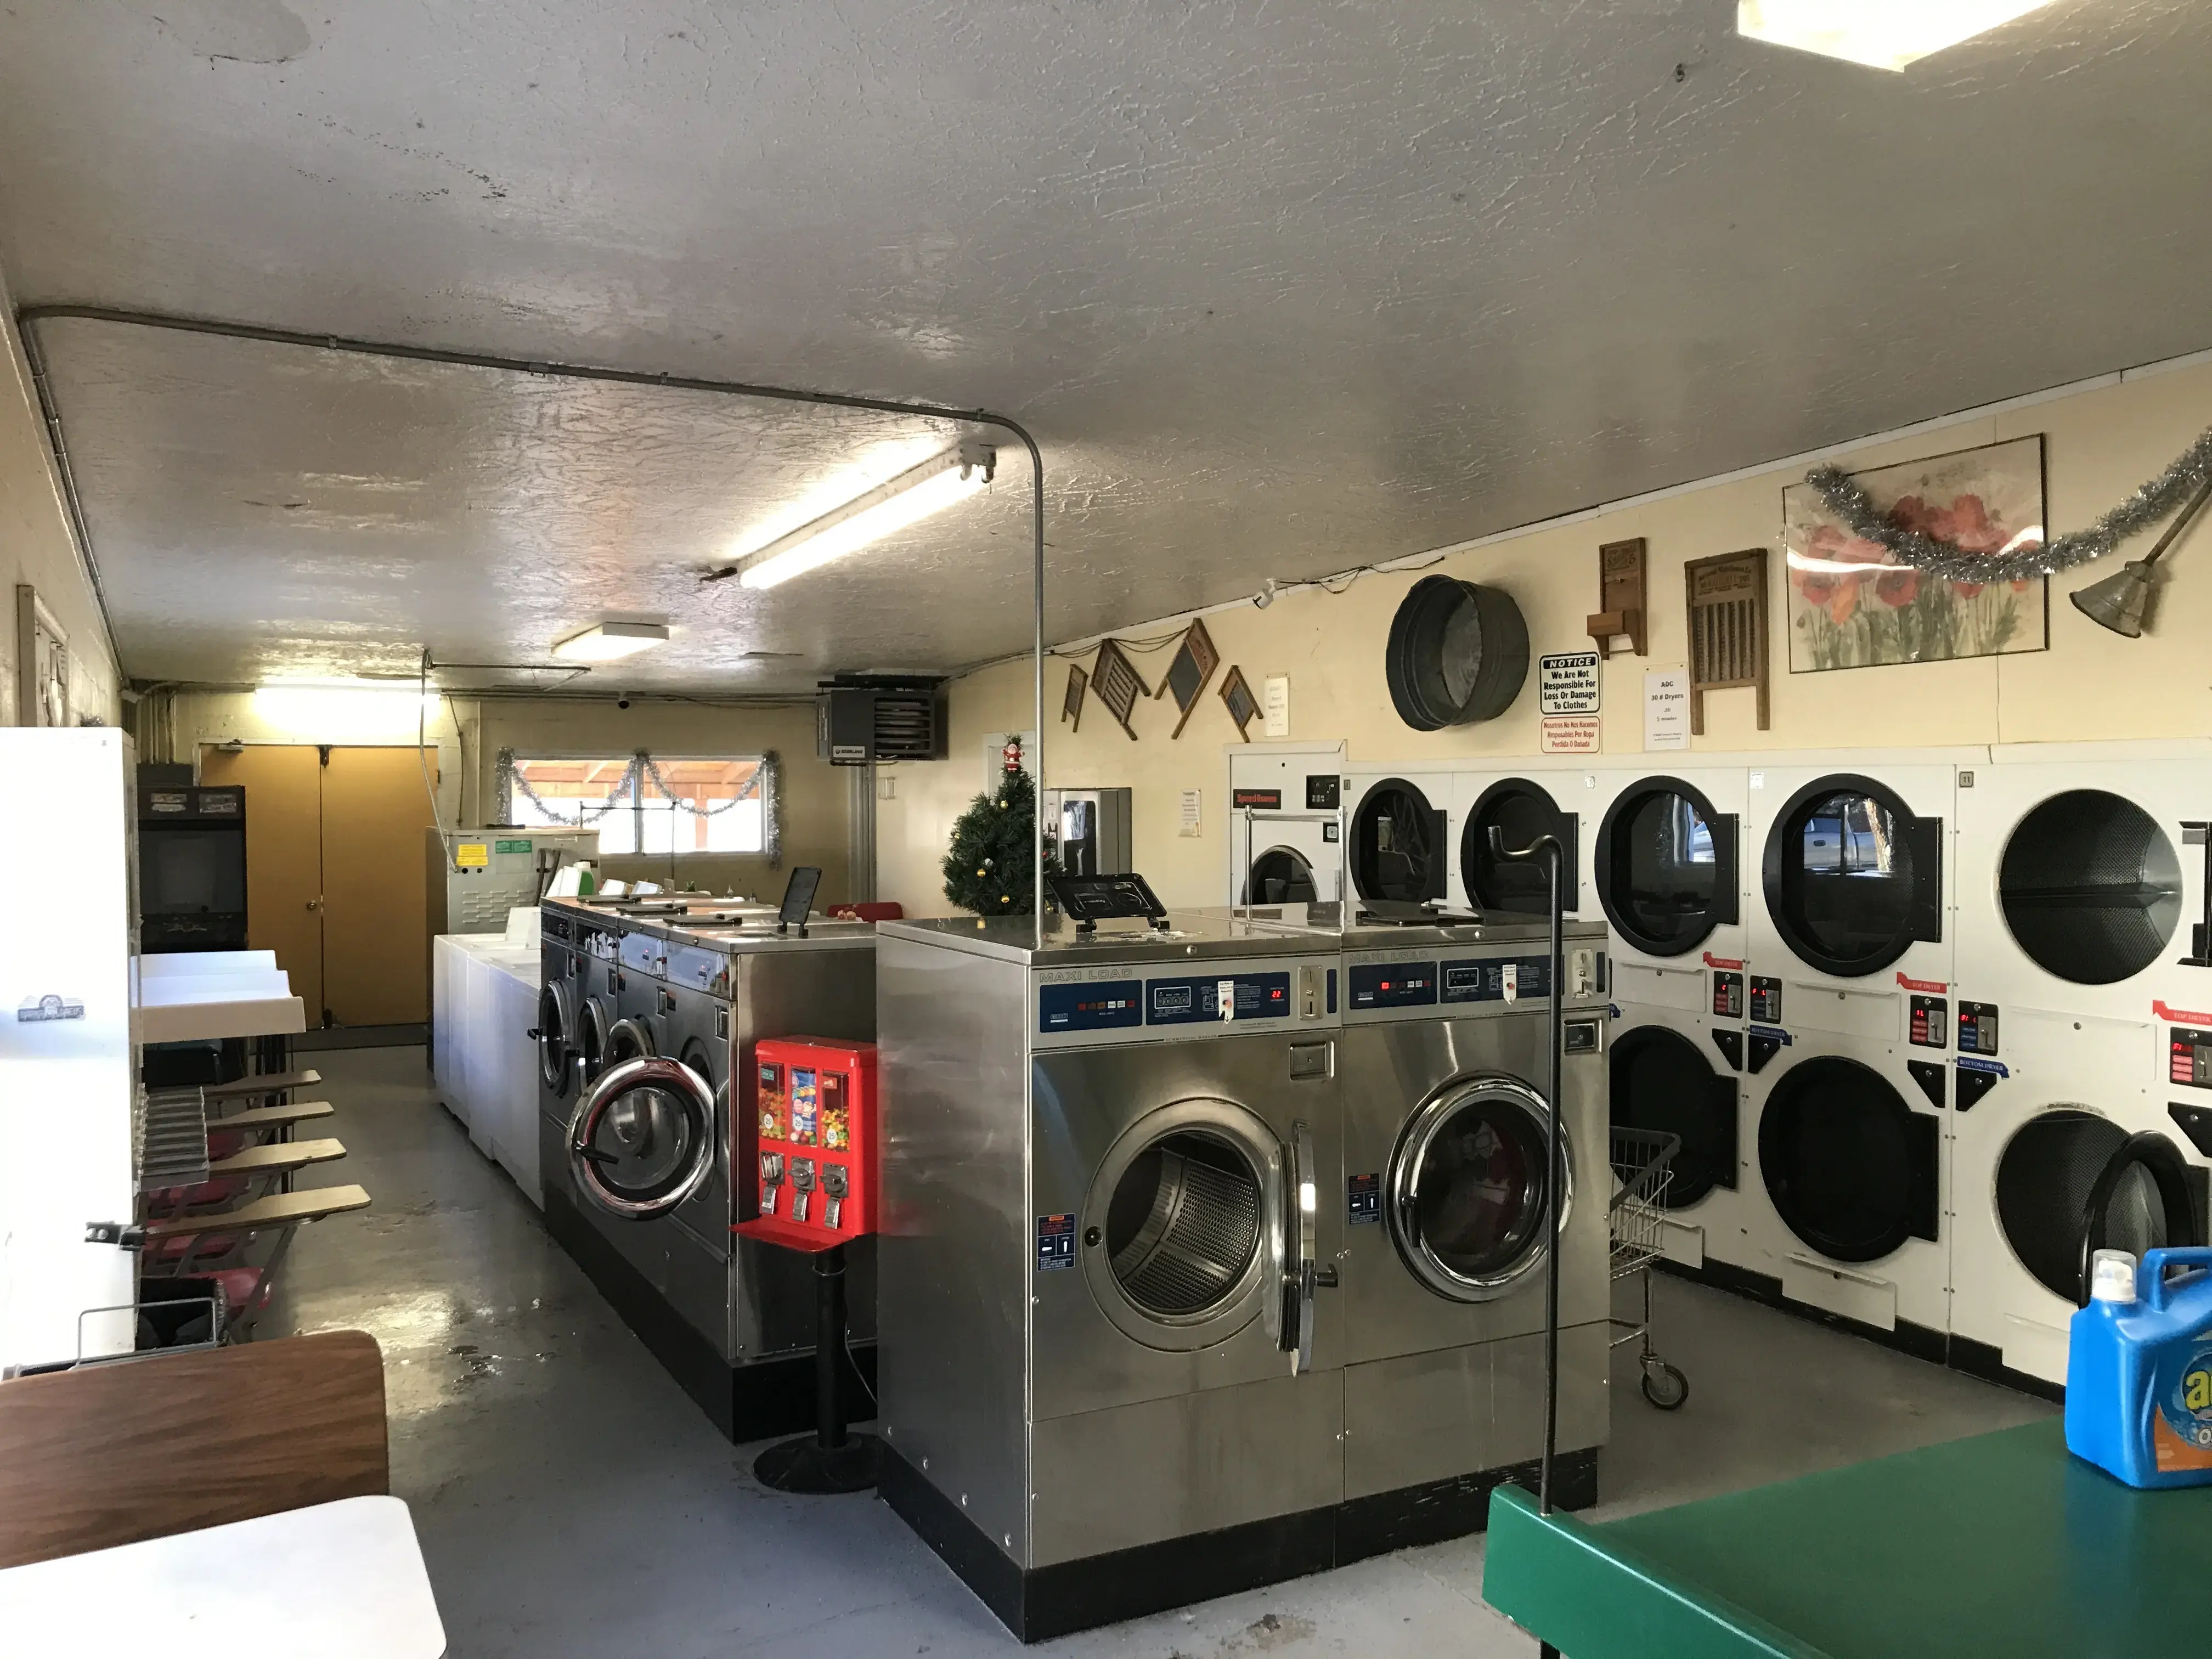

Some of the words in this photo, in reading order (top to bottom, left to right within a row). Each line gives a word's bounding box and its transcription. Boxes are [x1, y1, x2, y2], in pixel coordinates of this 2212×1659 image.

[1549, 658, 1592, 668] NOTICE
[1544, 680, 1584, 691] Responsible
[1571, 691, 1596, 699] Damage
[1237, 794, 1256, 803] Speed
[1257, 794, 1277, 803] Queen
[1348, 952, 1385, 963] MAXI
[1391, 950, 1429, 961] LOAD
[1039, 970, 1081, 983] MAXI
[1089, 968, 1132, 980] LOAD
[2188, 1013, 2211, 1022] DRYER
[1960, 1059, 1984, 1068] BOTTOM
